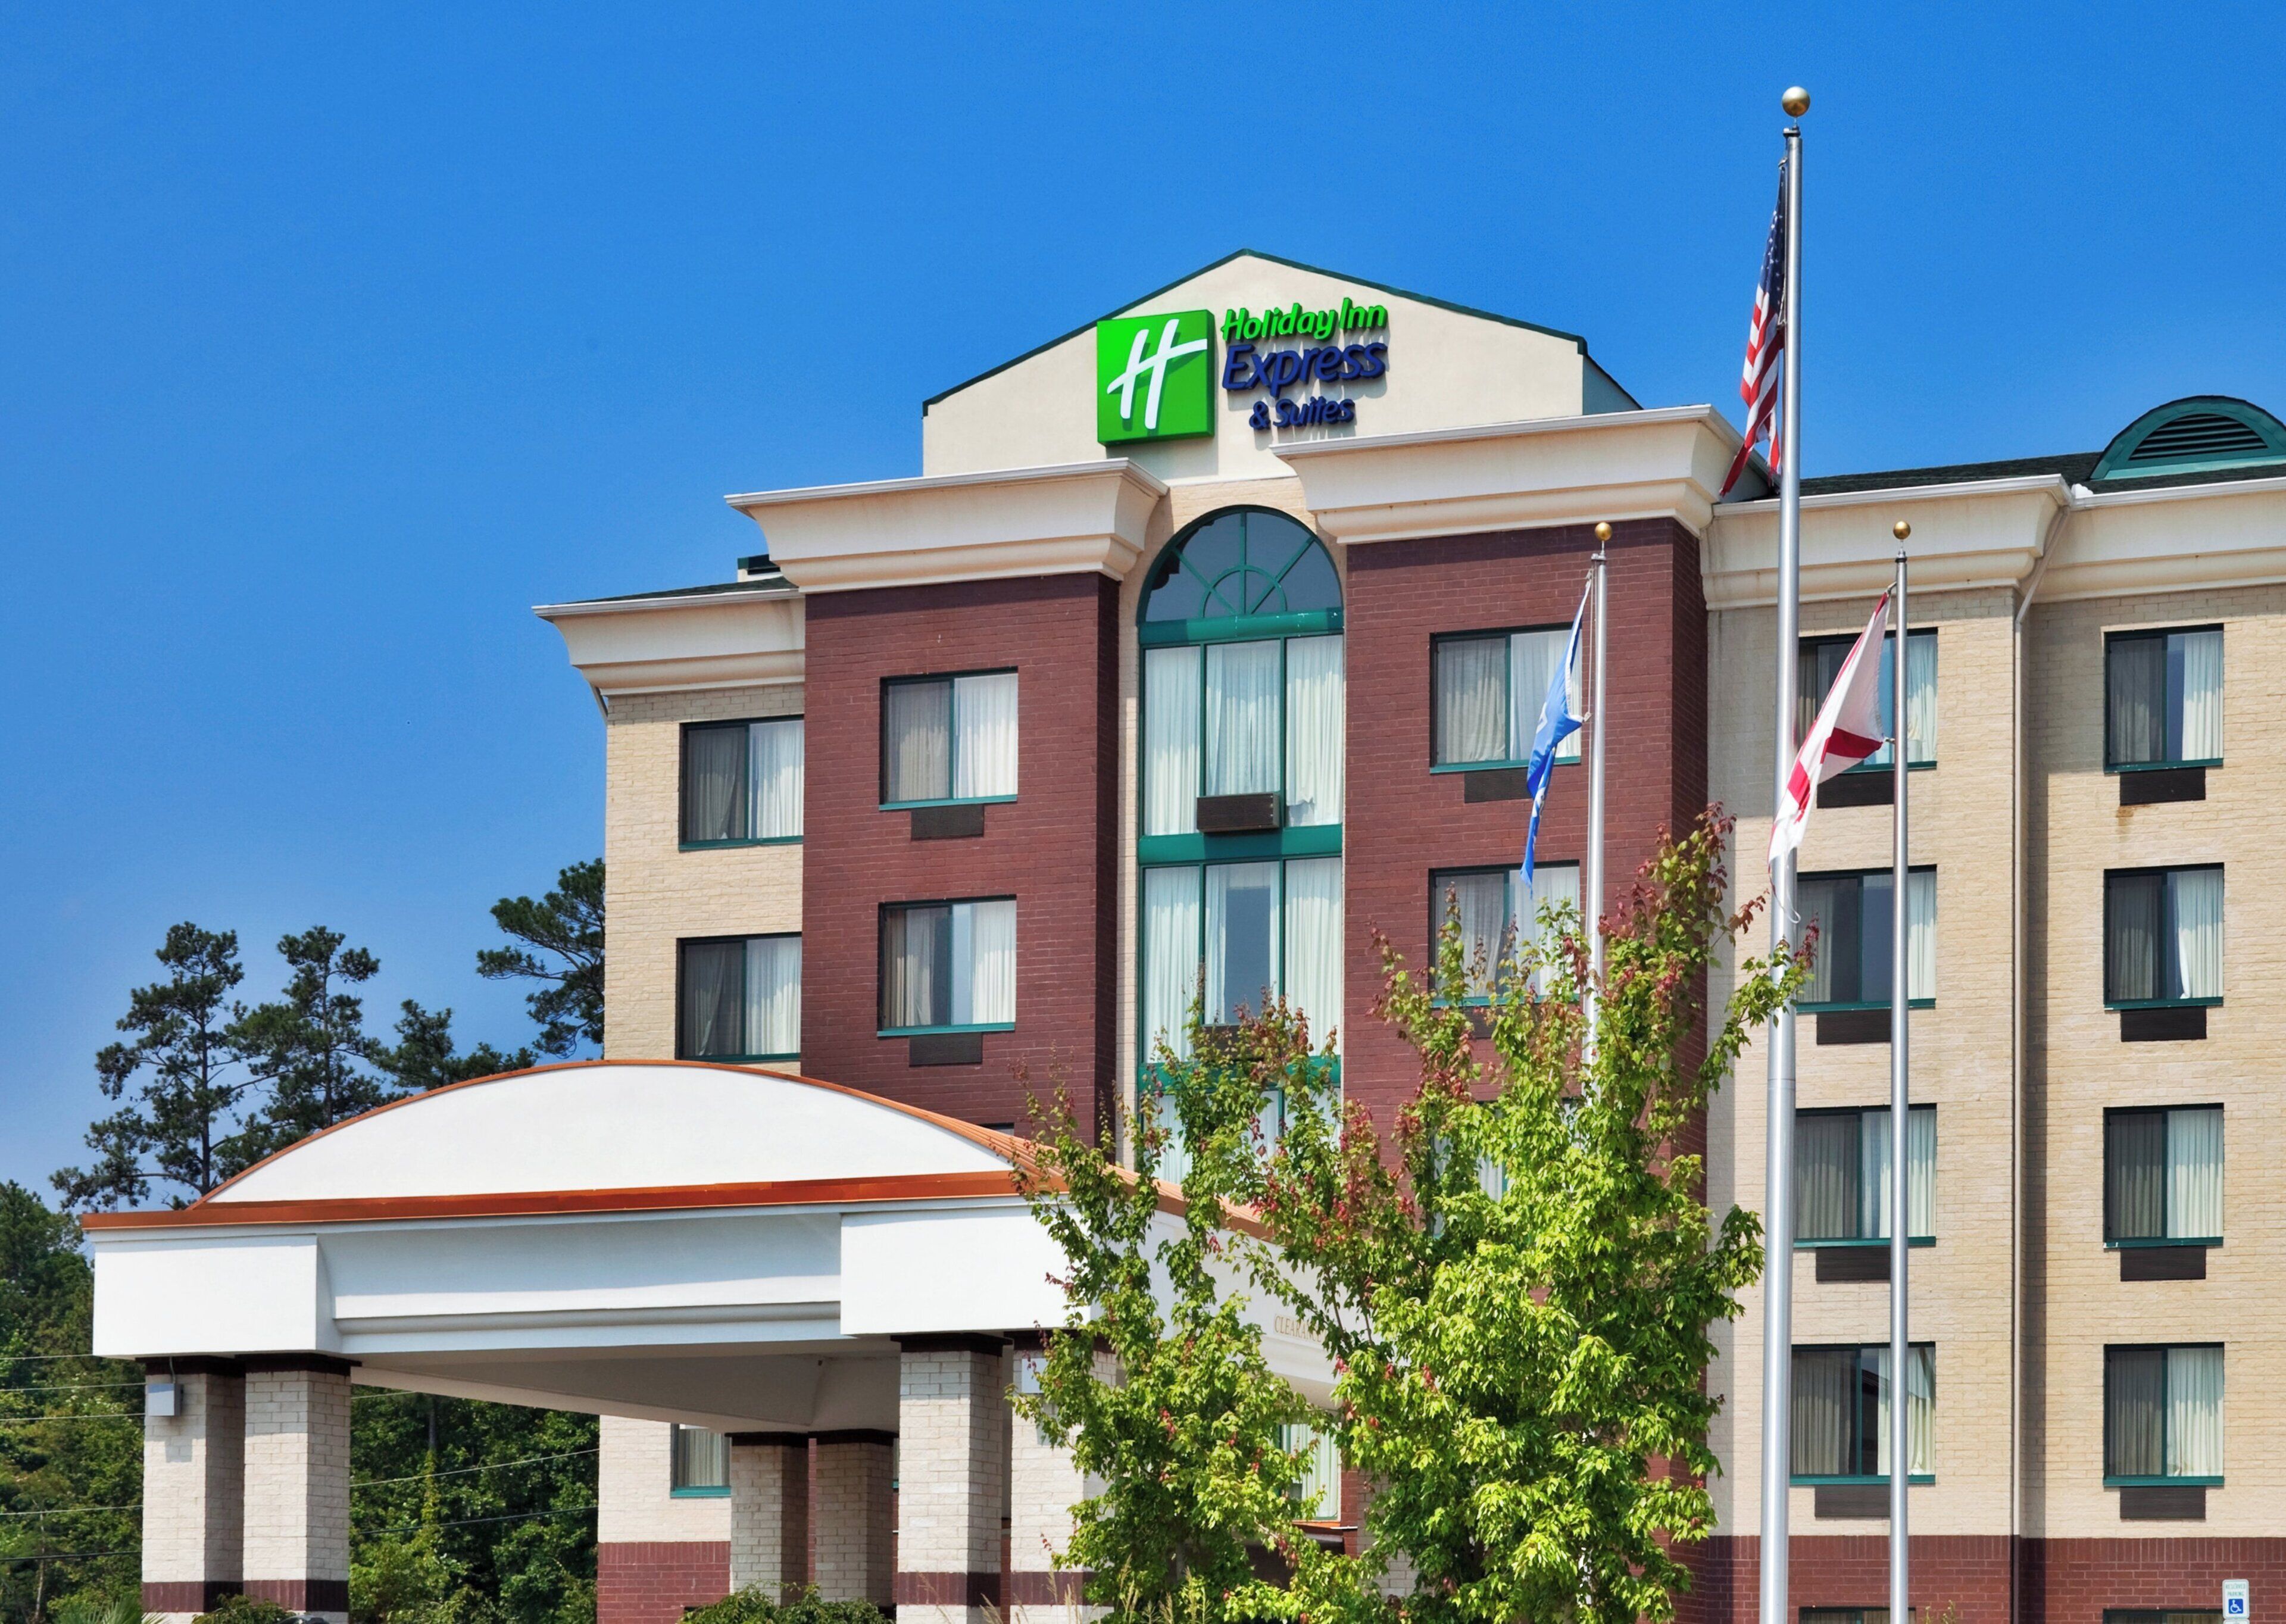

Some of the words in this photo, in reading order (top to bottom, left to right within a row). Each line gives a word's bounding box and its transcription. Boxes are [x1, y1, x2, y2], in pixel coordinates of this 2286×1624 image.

[1220, 302, 1338, 342] Holiday
[1339, 297, 1388, 330] Inn
[1222, 342, 1388, 399] Express
[1249, 400, 1270, 430] &
[1273, 396, 1356, 428] Suites
